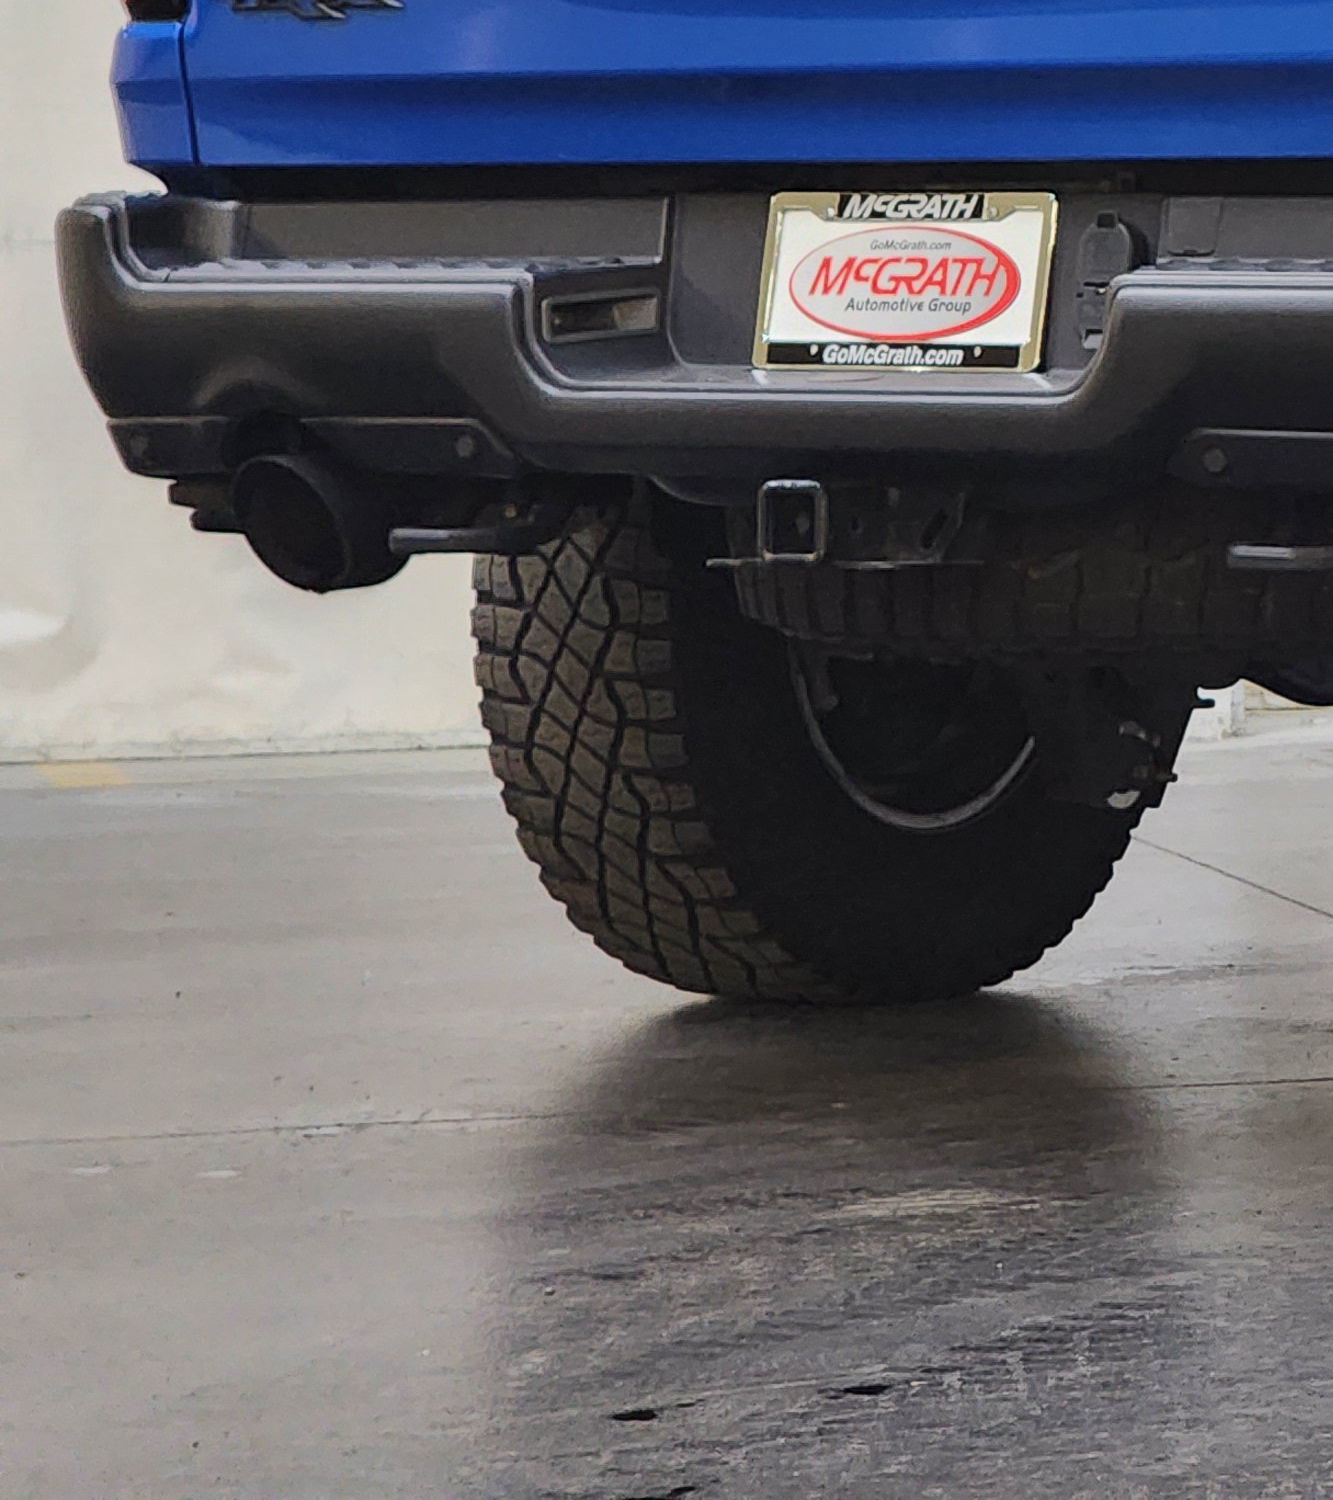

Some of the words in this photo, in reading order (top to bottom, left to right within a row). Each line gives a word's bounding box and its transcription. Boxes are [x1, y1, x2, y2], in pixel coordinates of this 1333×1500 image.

[870, 240, 952, 251] GoMcGrath.com
[845, 299, 924, 312] Automotive
[928, 299, 972, 315] Group
[822, 344, 965, 365] GoMcGrath.com
